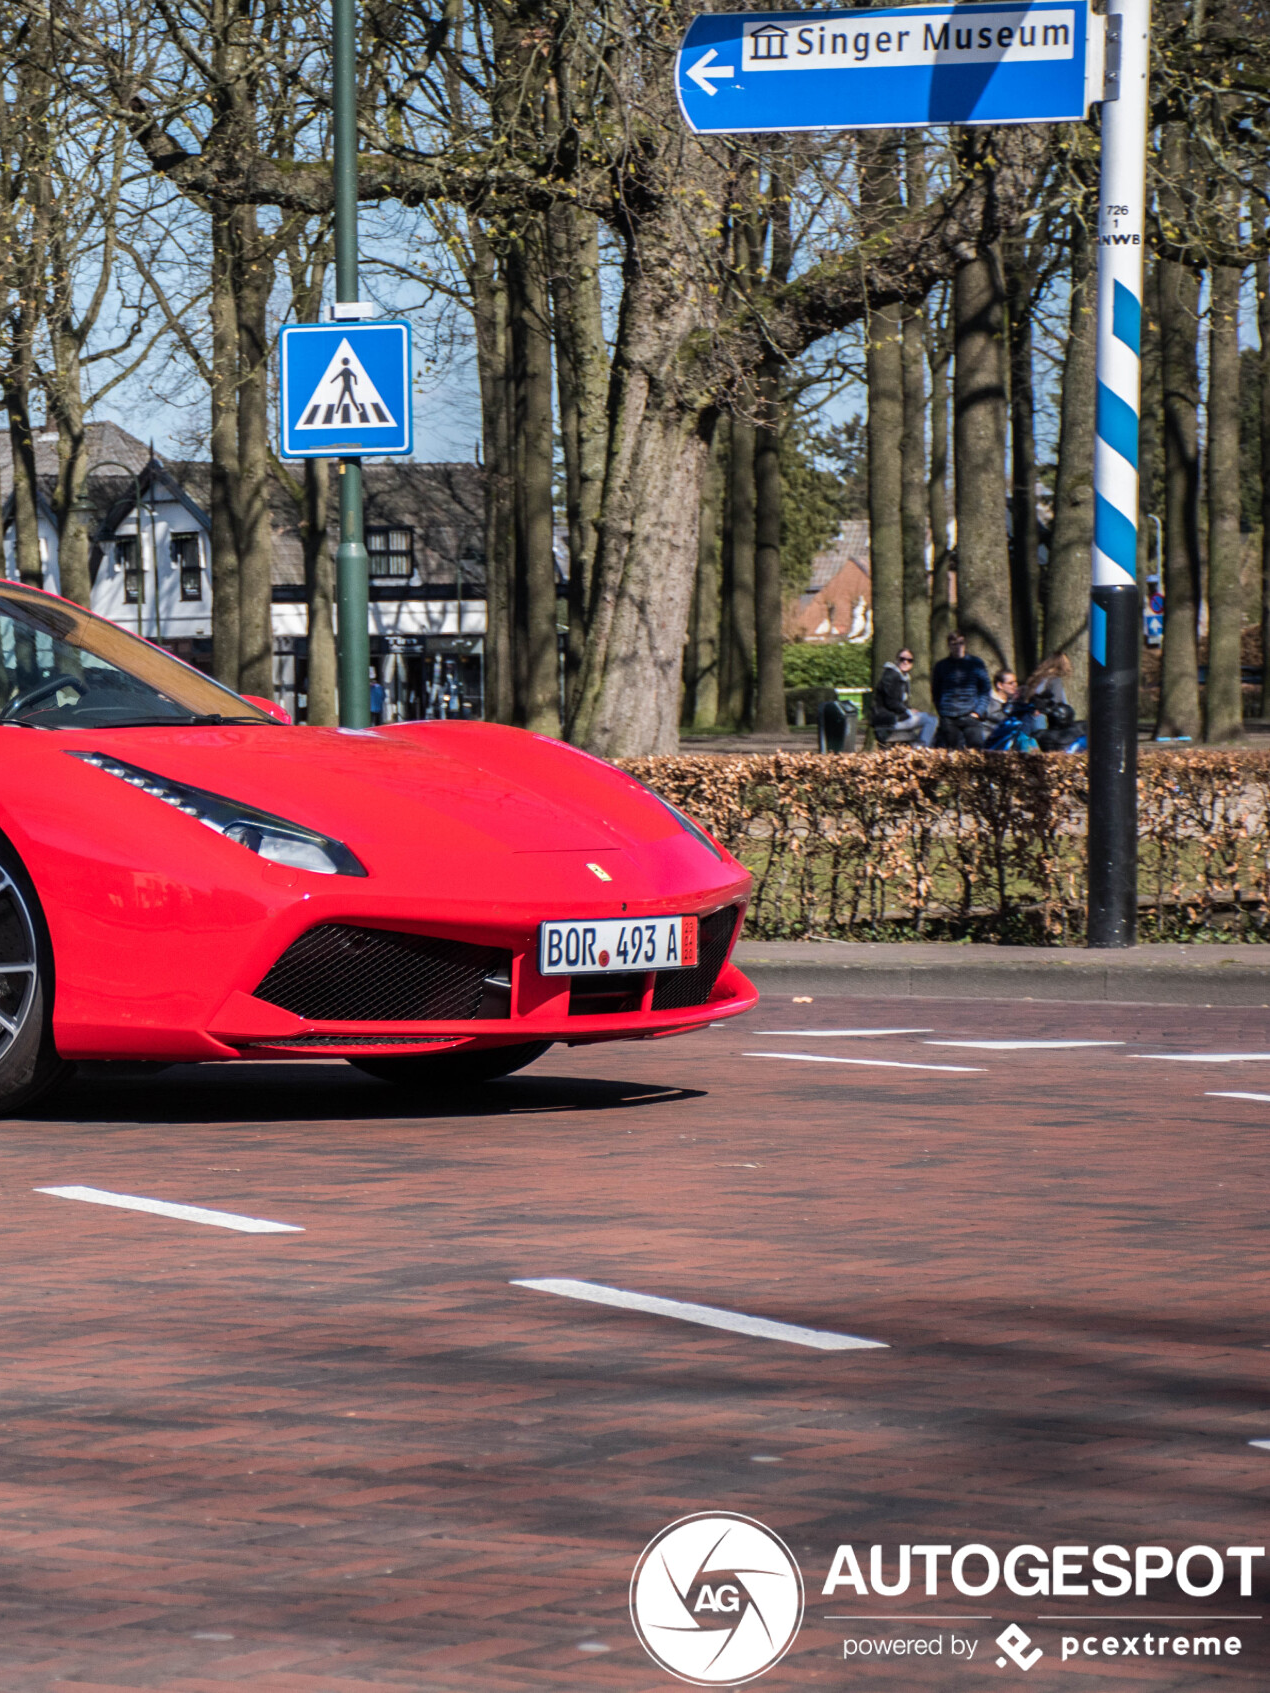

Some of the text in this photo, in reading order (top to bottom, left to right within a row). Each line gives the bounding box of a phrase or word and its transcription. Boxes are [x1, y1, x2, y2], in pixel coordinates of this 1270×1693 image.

[796, 22, 1070, 61] Singer Museum
[1106, 205, 1129, 215] 726
[1113, 218, 1119, 229] 1
[1099, 234, 1141, 246] NWB
[548, 923, 678, 967] BOR 493 A
